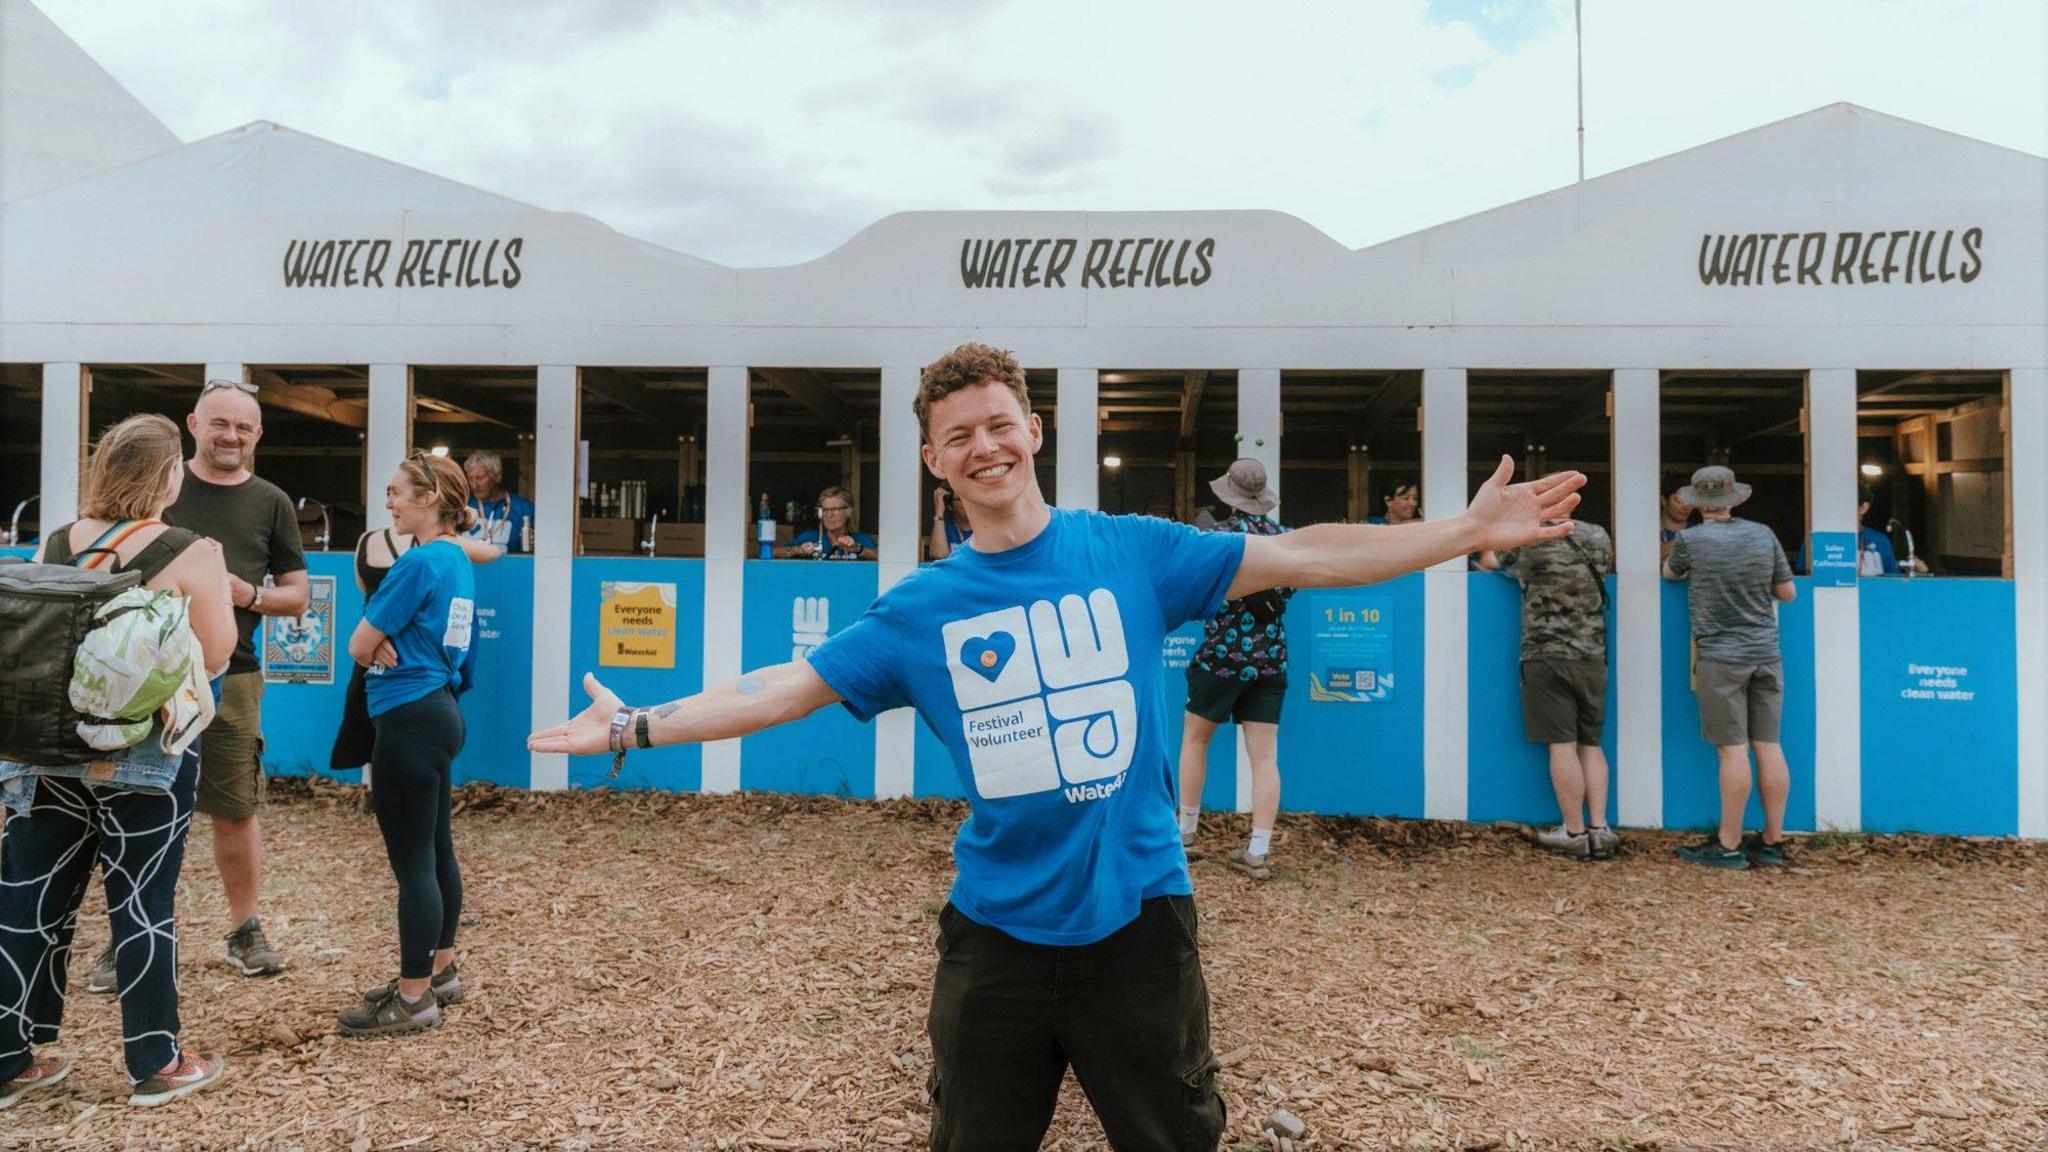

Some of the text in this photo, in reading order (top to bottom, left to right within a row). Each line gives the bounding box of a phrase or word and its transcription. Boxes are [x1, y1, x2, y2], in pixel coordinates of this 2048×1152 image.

[283, 238, 523, 289] WATER REFILLS
[960, 238, 1216, 289] WATER REFILLS
[1698, 227, 1983, 287] WATER REFILLS
[614, 604, 663, 616] Everyone
[1325, 607, 1380, 624] 1 in 10
[622, 616, 654, 626] needs
[1164, 636, 1196, 647] ryone
[1168, 659, 1191, 668] wat
[1908, 664, 1968, 678] Everyone
[1918, 677, 1957, 688] needs
[1900, 688, 1975, 701] clean water
[969, 710, 1025, 733] Festival
[970, 726, 1043, 748] Volunteer
